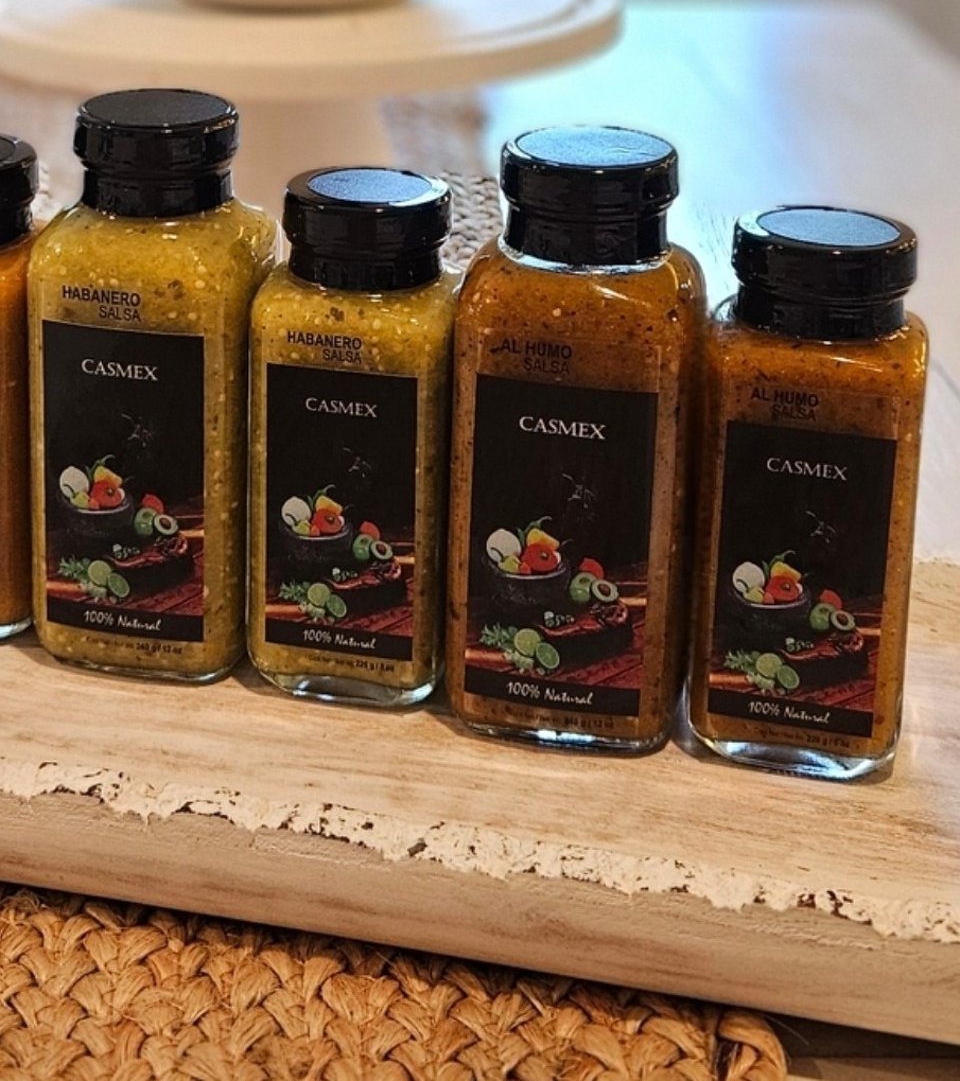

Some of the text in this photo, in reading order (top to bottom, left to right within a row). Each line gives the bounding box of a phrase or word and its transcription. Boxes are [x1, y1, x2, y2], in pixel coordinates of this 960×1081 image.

[61, 285, 141, 307] HABANERO
[99, 305, 141, 322] SALSA
[287, 330, 362, 350] HABANERO
[499, 337, 573, 359] AL HUMO
[322, 348, 362, 364] SALSA
[523, 358, 570, 375] SALSA
[81, 359, 159, 381] CASMEX
[305, 397, 378, 418] CASMEX
[751, 387, 820, 408] AL HUMO
[519, 416, 607, 440] CASMEX
[766, 457, 848, 481] CASMEX
[83, 610, 162, 631] 100% Natural
[303, 629, 377, 649] 100% Natural
[506, 681, 594, 705] 100% Natural
[748, 701, 831, 724] 100% Natural
